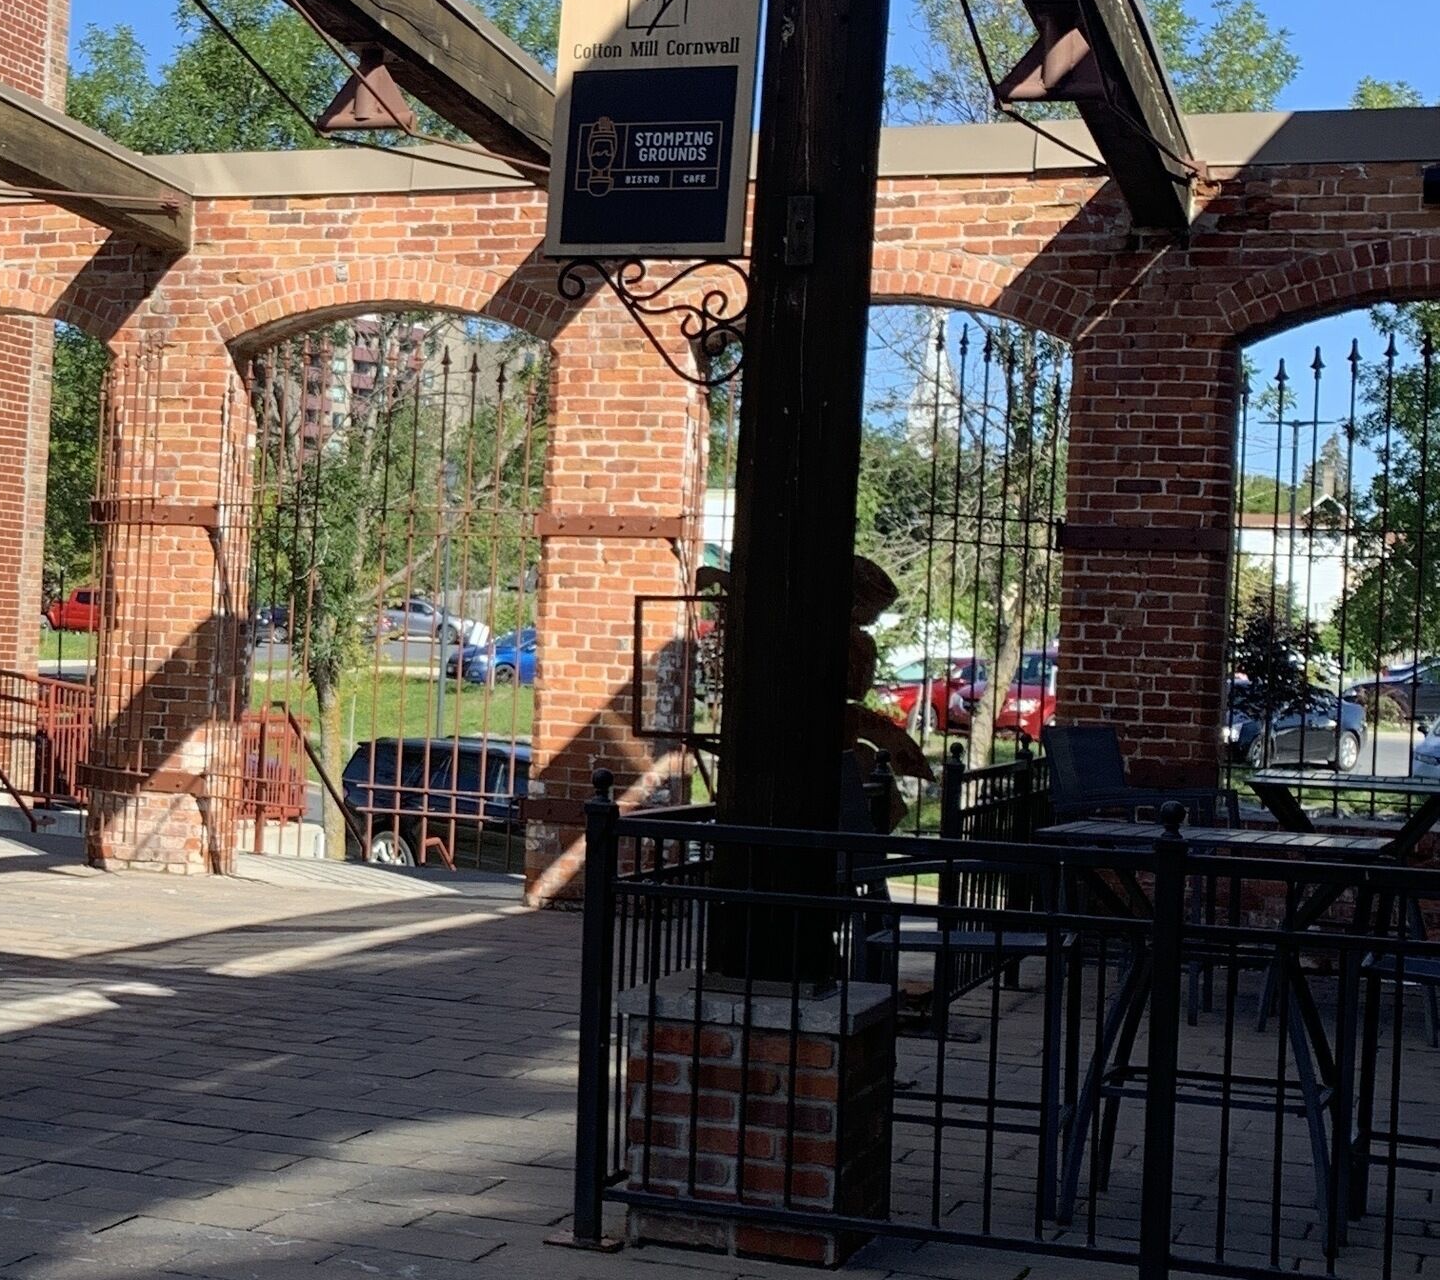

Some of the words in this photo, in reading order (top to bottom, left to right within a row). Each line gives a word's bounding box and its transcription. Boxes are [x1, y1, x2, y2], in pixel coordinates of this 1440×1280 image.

[574, 43, 622, 59] Cotton
[630, 40, 658, 57] Mill
[667, 37, 740, 56] Cornwall
[635, 131, 714, 147] STOMPING
[638, 147, 707, 161] GROUNDS
[625, 174, 660, 184] BISTRO
[683, 174, 706, 184] CAFE
